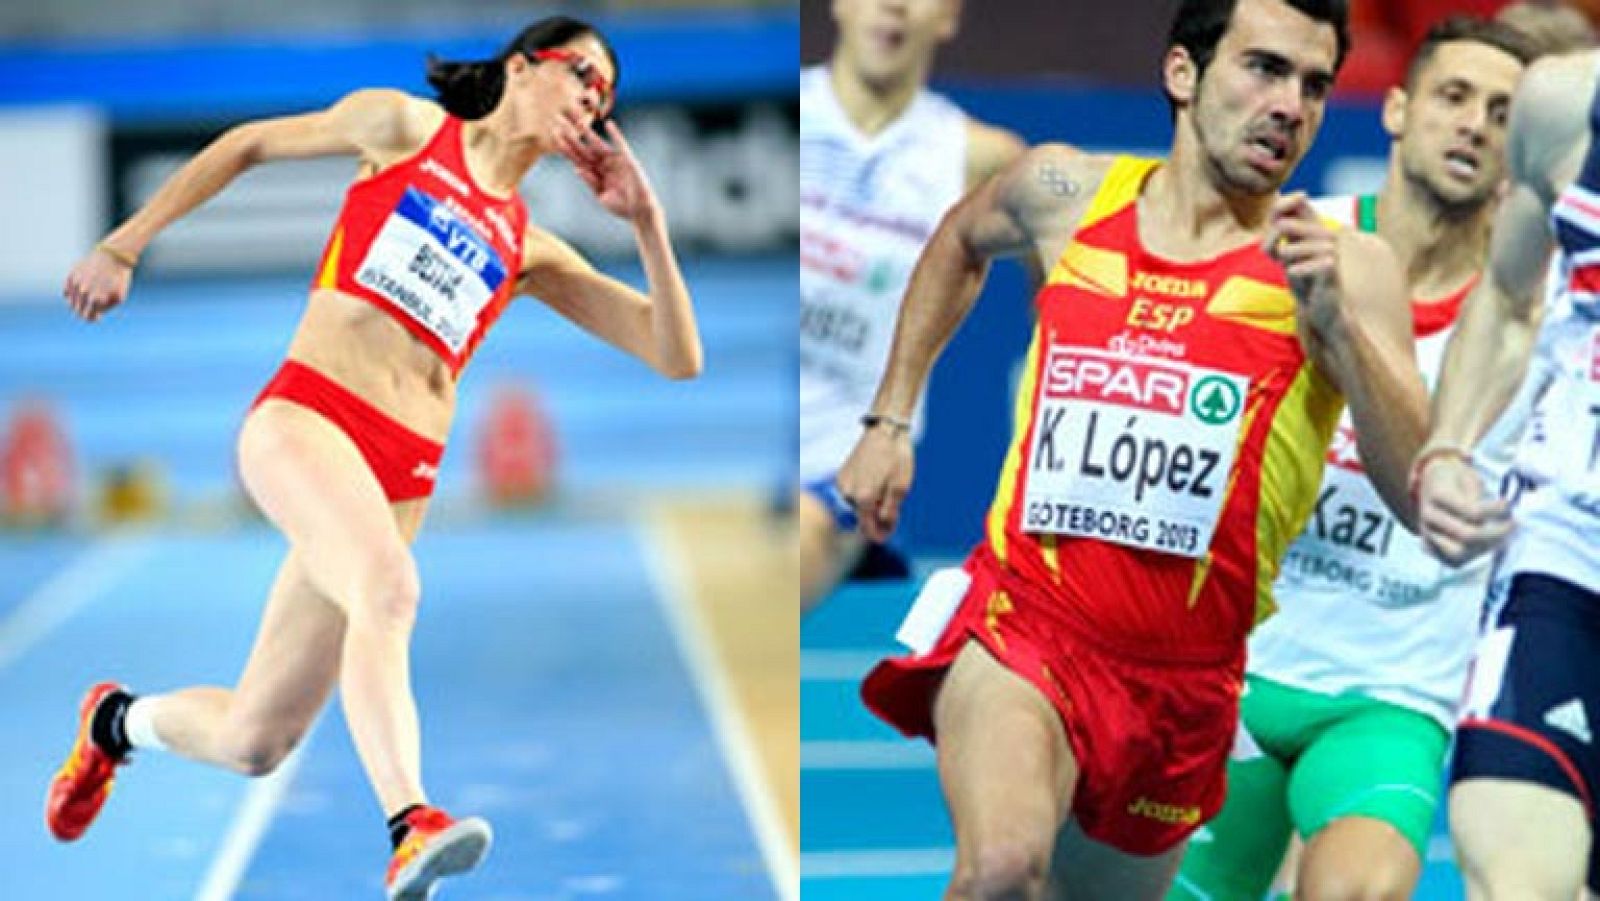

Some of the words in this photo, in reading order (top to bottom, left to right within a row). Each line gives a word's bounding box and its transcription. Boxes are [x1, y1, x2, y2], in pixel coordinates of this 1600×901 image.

[1126, 298, 1194, 332] ESP
[1050, 358, 1184, 411] SPAR
[1034, 406, 1065, 472] K.
[1080, 410, 1221, 503] López
[1028, 501, 1149, 542] GÖTEBORG
[1156, 519, 1200, 552] 2013
